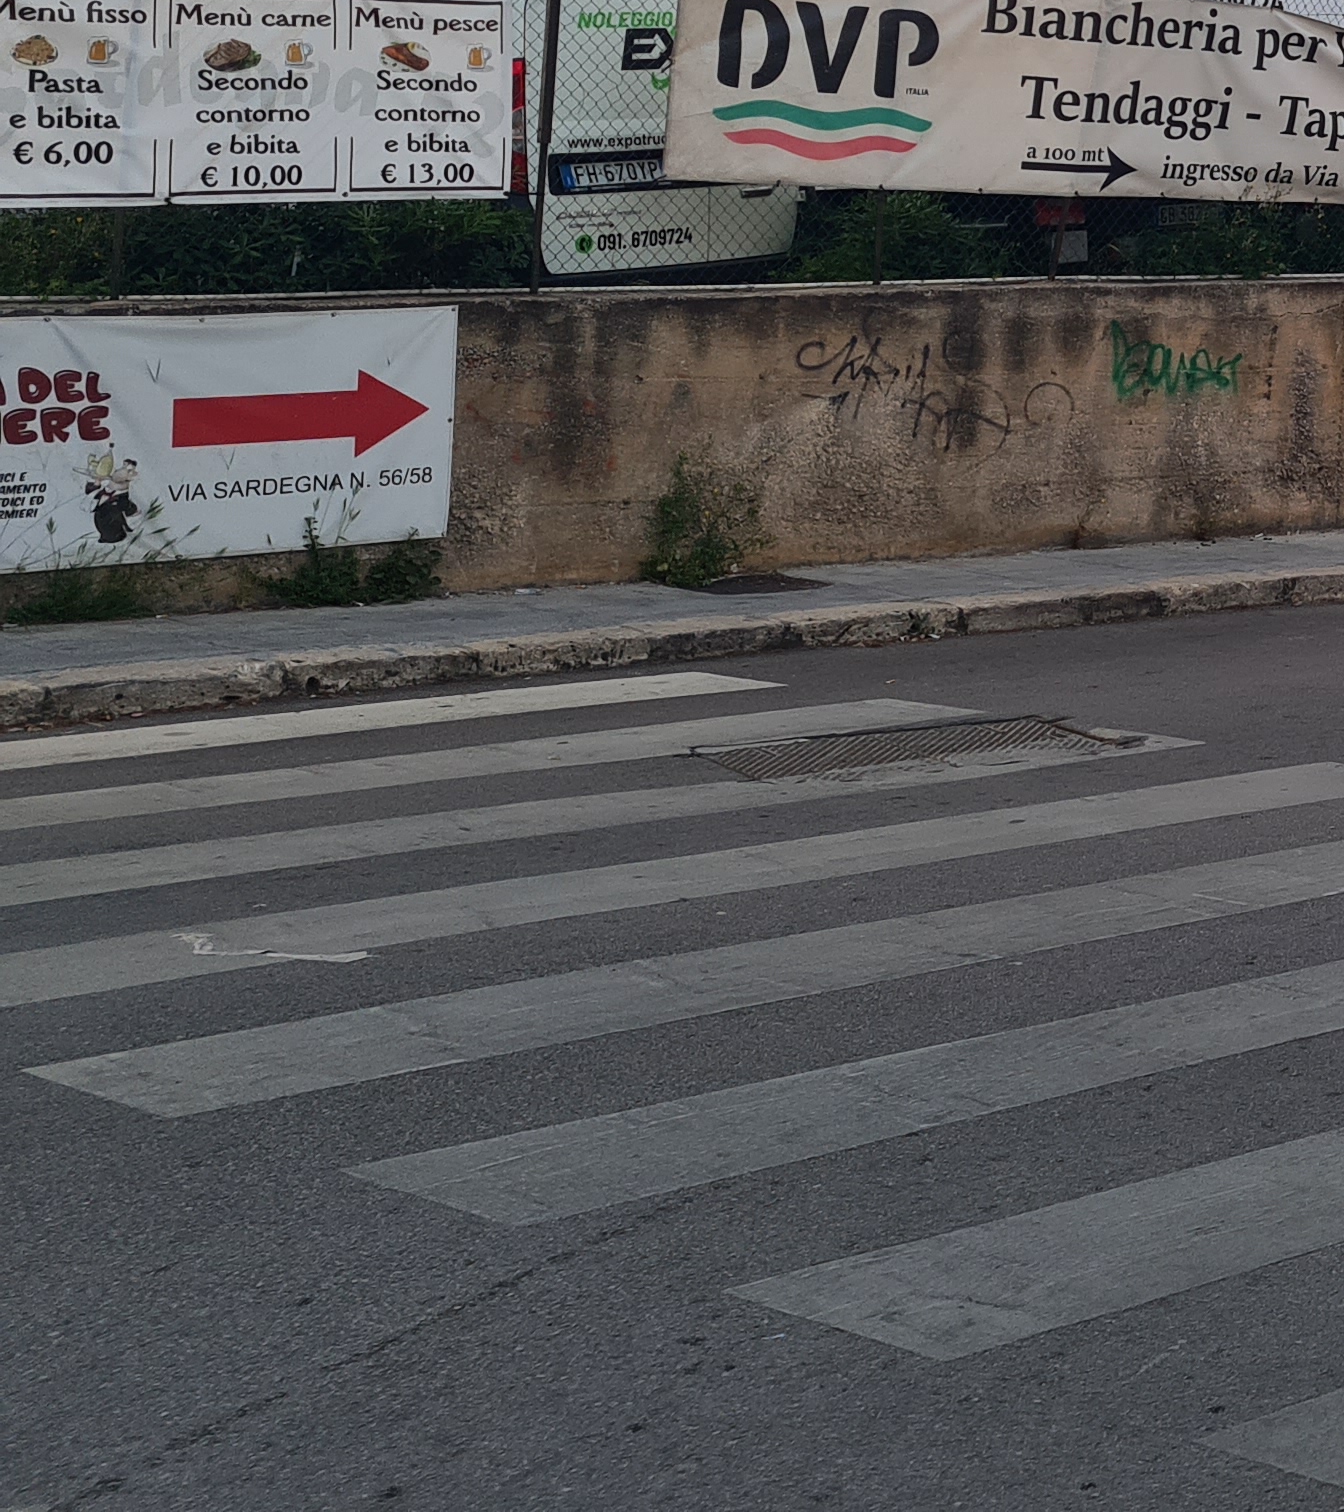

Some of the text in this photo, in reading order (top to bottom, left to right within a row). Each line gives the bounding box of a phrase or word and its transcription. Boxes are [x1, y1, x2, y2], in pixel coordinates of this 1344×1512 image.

[86, 0, 147, 24] fisso
[175, 3, 332, 27] Menù carne
[355, 7, 499, 35] Menù pesce
[577, 11, 674, 29] NOLEGGIO
[1253, 28, 1328, 71] per
[28, 69, 104, 94] Pasta
[198, 69, 309, 91] Secondo
[376, 70, 478, 93] Secondo
[905, 87, 929, 96] ITALIA
[9, 106, 121, 130] e bibita
[196, 107, 311, 124] contorno
[374, 107, 481, 123] contorno
[1020, 75, 1233, 141] Tendaggi
[13, 140, 114, 168] € 6,00
[206, 134, 301, 155] e bibita
[384, 132, 472, 153] e bibita
[1026, 146, 1105, 162] a 100 mt
[201, 164, 303, 189] € 10,00
[380, 162, 475, 186] € 13,00
[1160, 154, 1258, 187] ingresso
[1265, 161, 1294, 184] da
[1303, 165, 1339, 188] Via
[18, 367, 112, 404] DEL
[0, 405, 111, 445] ERE
[168, 466, 433, 502] VIA SARDEGNA N. 56/58
[0, 495, 45, 507] DICI ED
